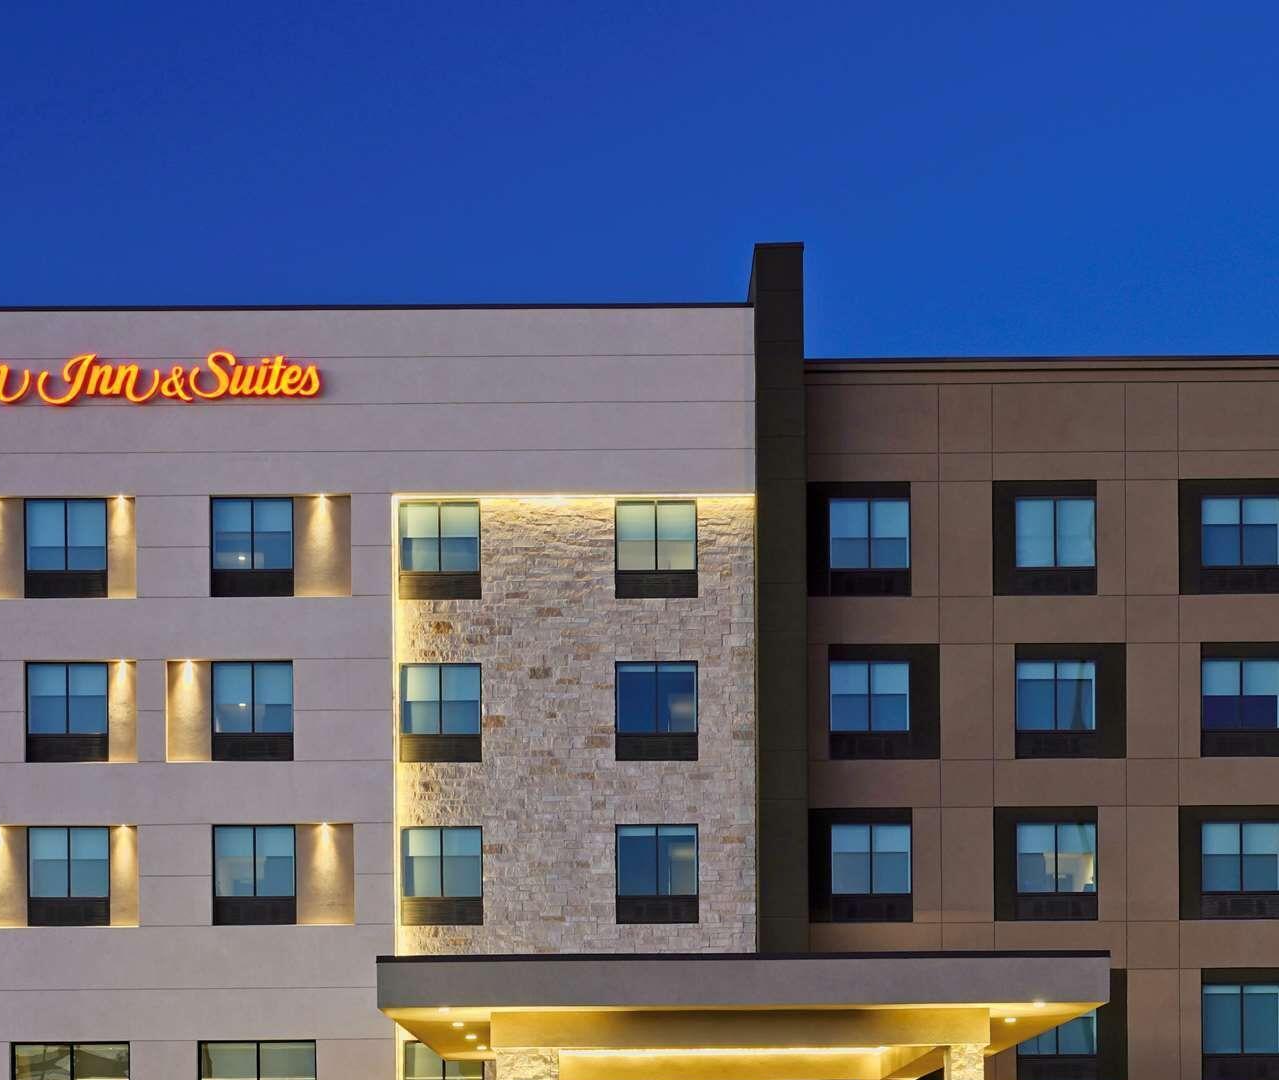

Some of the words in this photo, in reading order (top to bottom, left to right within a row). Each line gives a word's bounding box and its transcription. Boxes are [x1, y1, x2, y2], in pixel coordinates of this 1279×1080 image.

[37, 352, 160, 405] Inn
[160, 366, 193, 401] &
[189, 351, 320, 400] Suites
